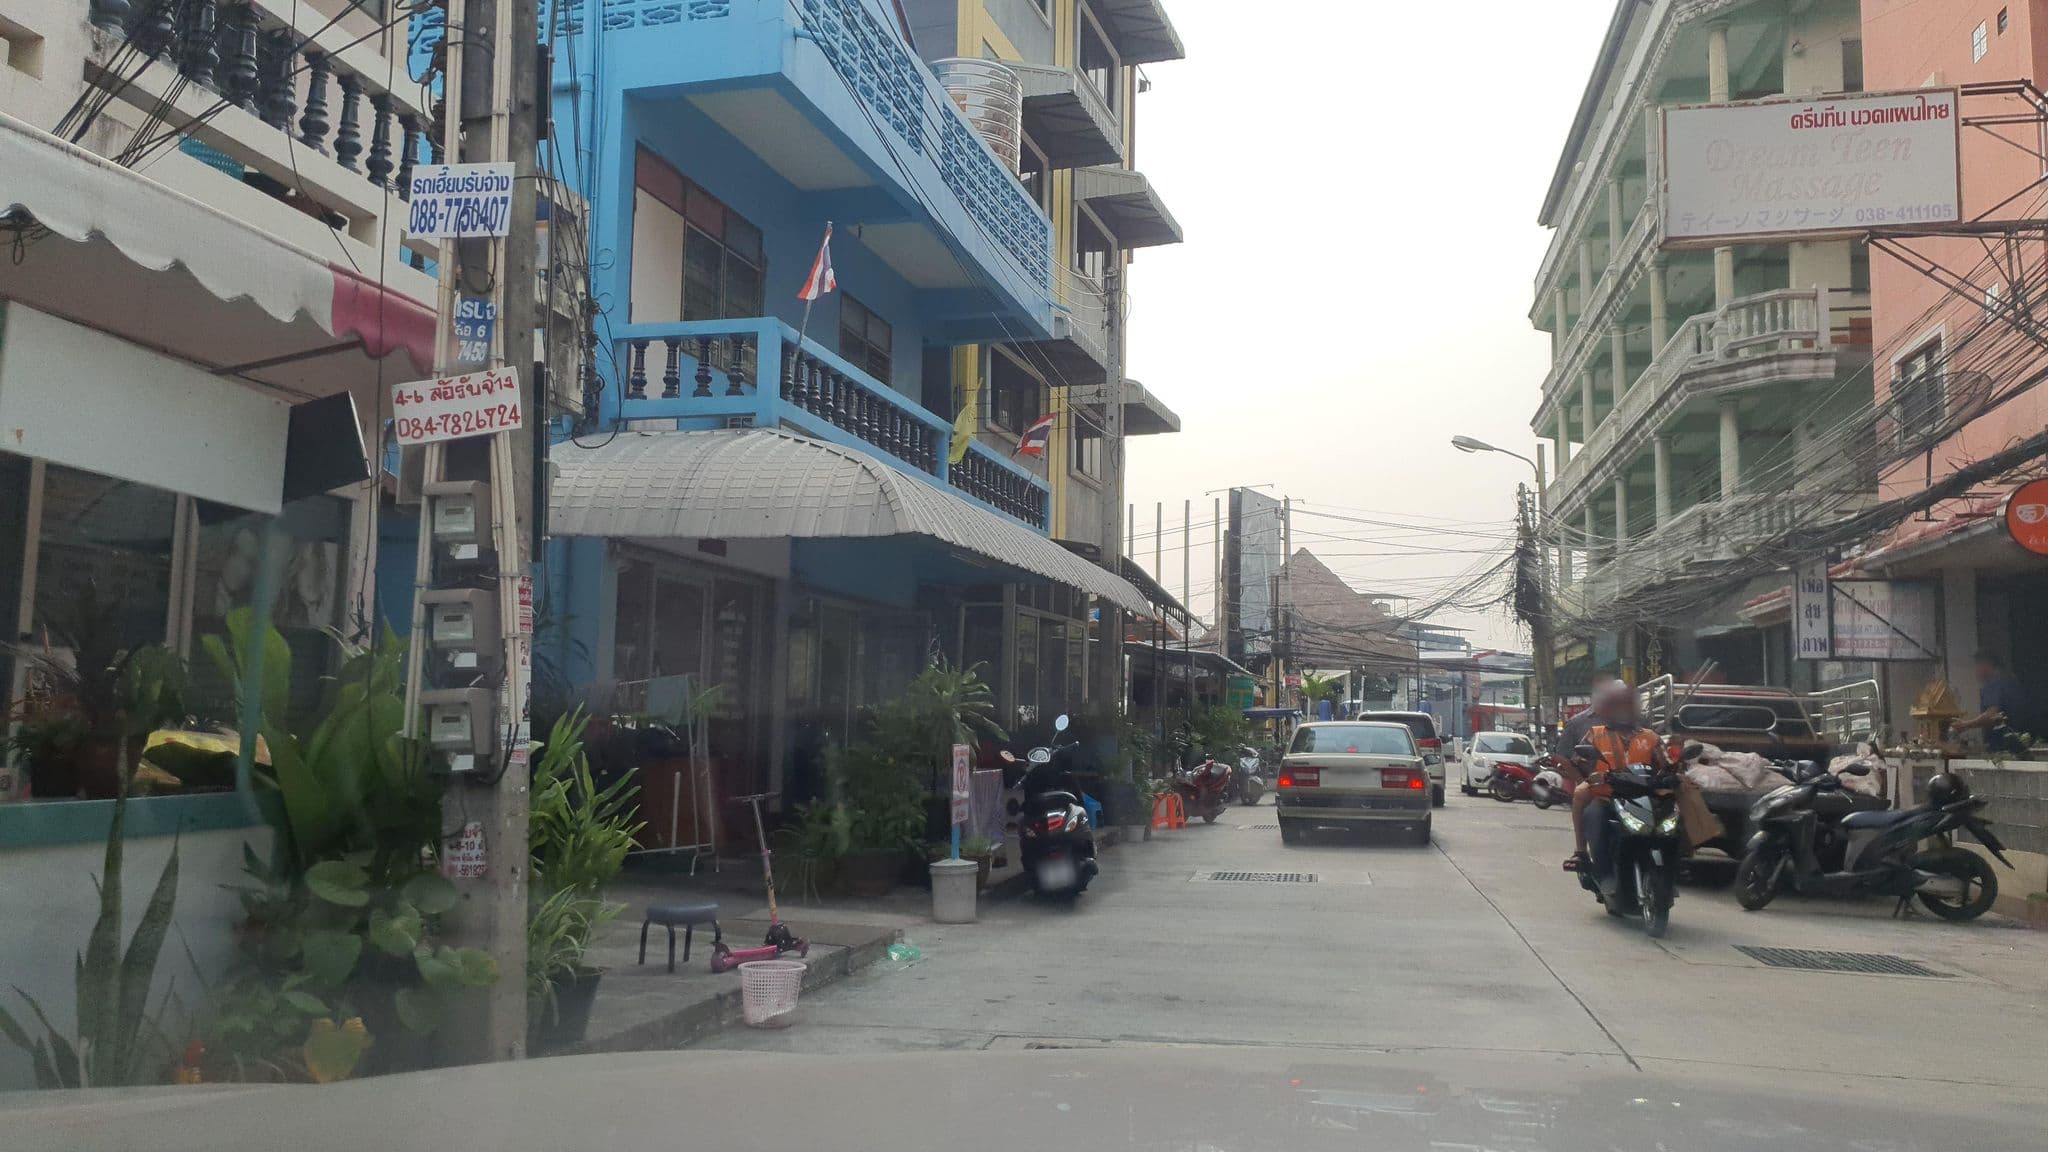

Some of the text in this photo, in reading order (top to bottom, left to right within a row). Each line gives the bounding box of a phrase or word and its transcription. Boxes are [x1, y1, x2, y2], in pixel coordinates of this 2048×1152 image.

[1851, 96, 1949, 126] นวดแผนไทย
[1705, 129, 1913, 171] Dream Teen
[1730, 171, 1883, 206] Massage
[410, 196, 509, 233] 088-7750407
[1855, 204, 1953, 222] 038-411105
[397, 404, 521, 440] 084-7826724
